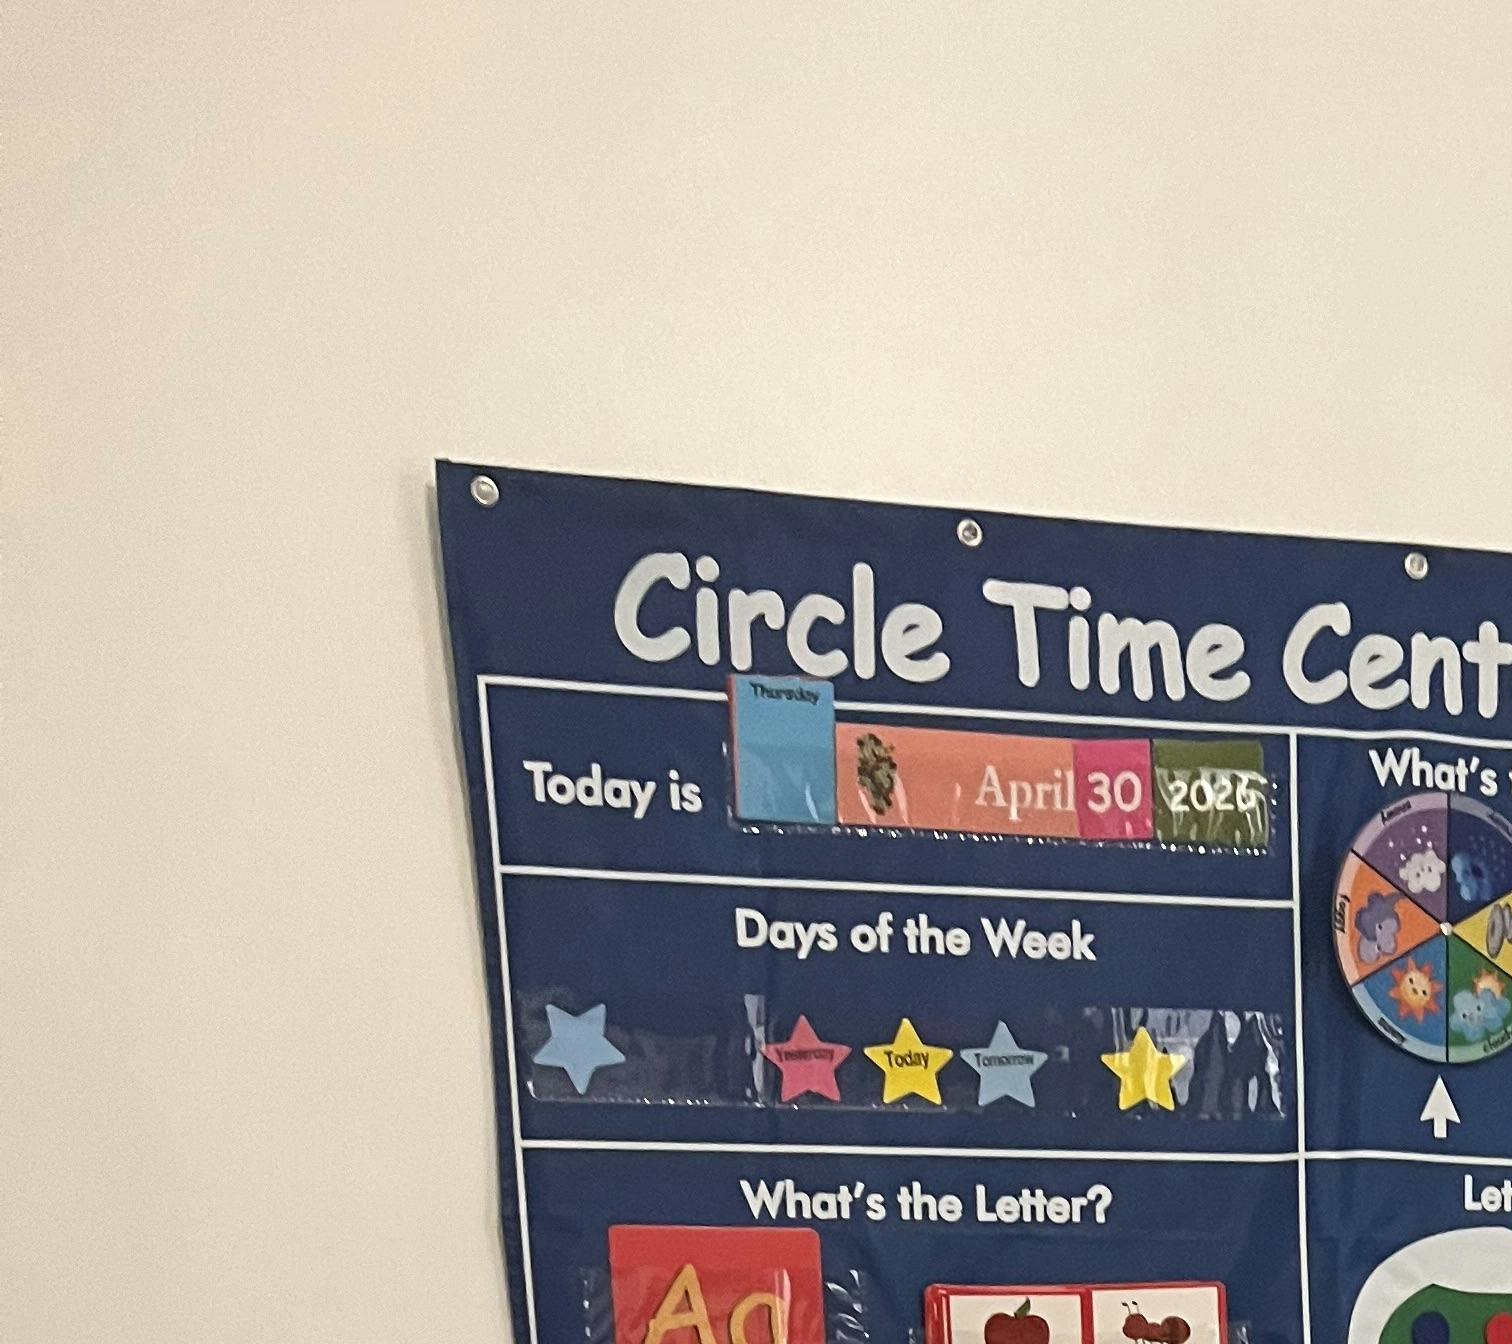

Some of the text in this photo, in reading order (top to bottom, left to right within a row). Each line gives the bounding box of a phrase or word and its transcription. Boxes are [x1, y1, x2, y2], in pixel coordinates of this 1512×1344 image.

[614, 552, 950, 683] Circle
[982, 578, 1247, 702] Time
[749, 681, 820, 705] Thursday
[524, 760, 703, 813] Today is
[975, 764, 1075, 823] April
[1087, 771, 1142, 813] 30
[1368, 746, 1498, 796] What's
[736, 908, 1097, 962] Days of the Week
[883, 1050, 930, 1070] Today
[974, 1053, 1035, 1067] Tomorrow
[740, 1178, 1113, 1224] What's the Letter?
